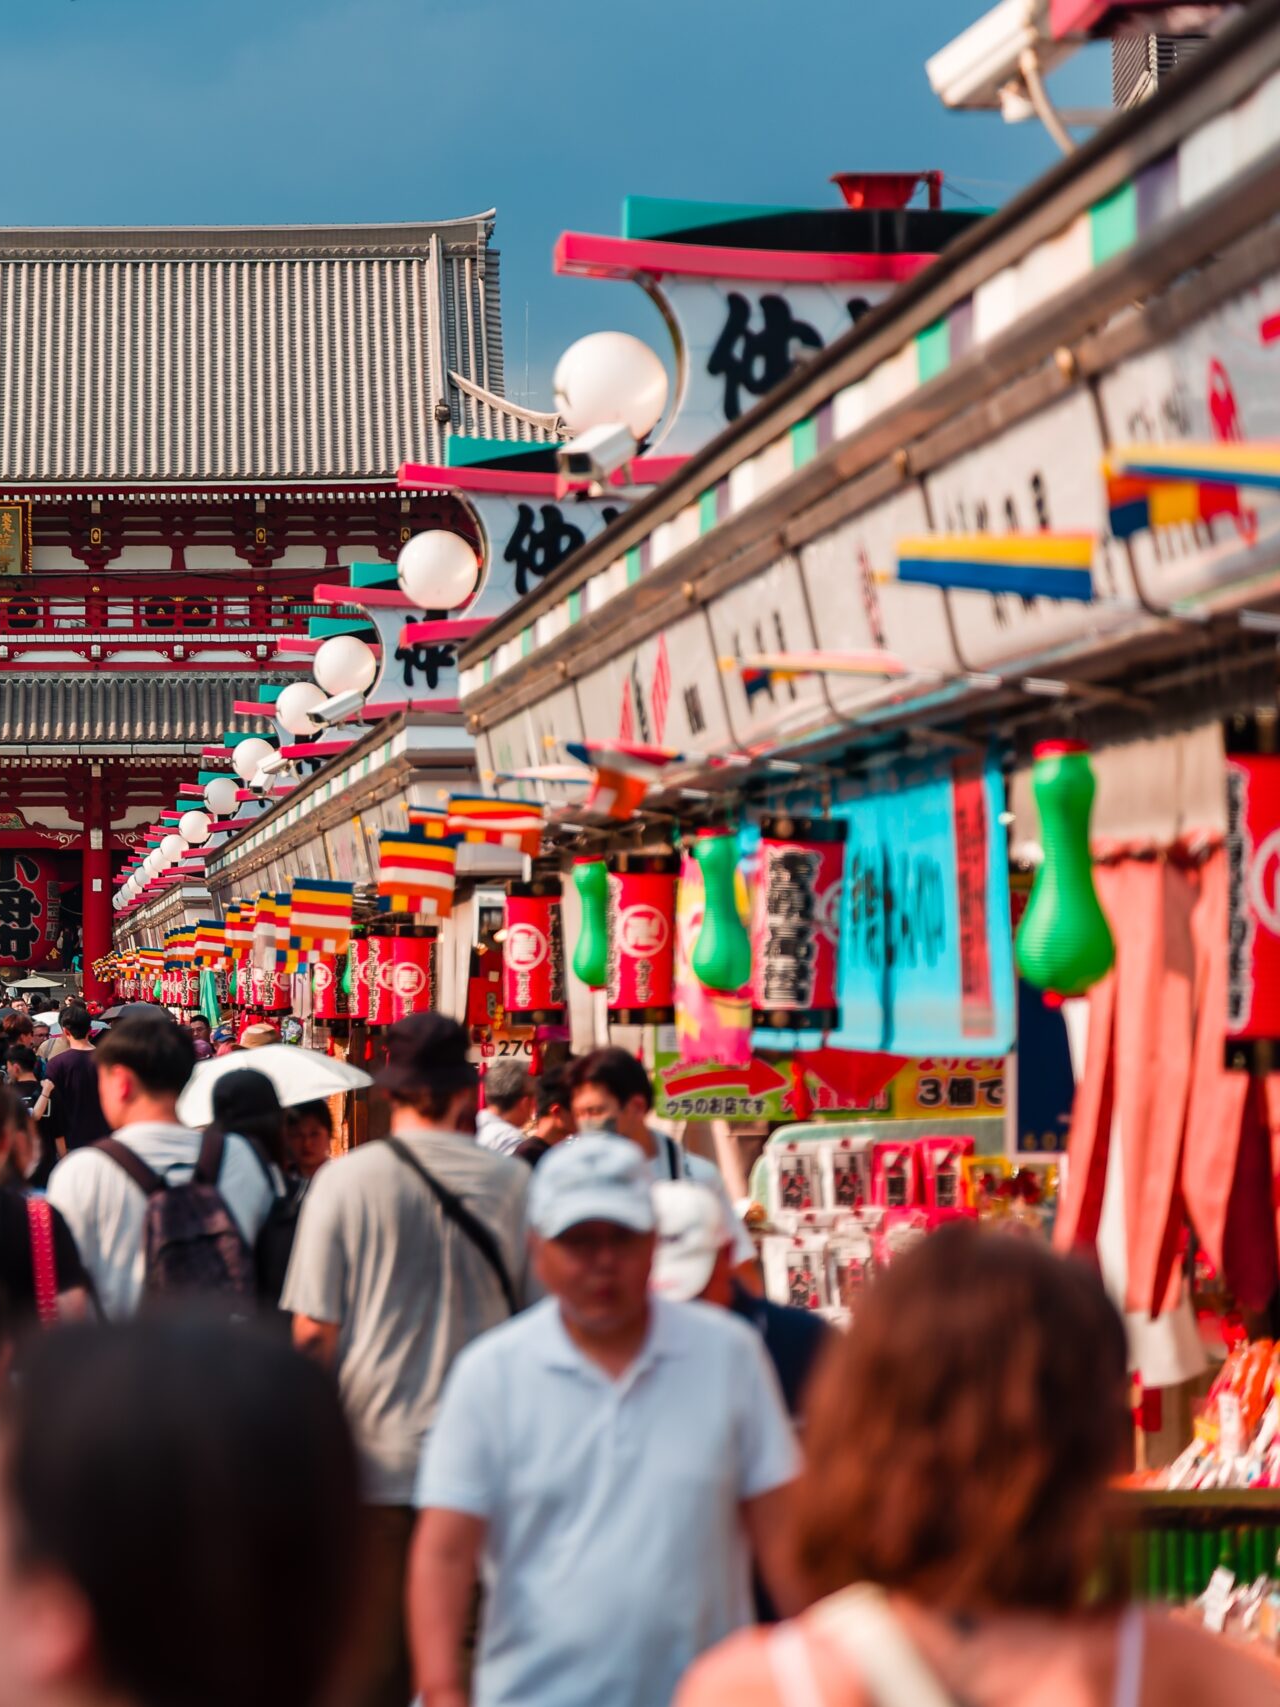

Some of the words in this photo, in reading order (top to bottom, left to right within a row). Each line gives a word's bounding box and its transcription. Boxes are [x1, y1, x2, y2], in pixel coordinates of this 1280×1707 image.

[665, 1097, 766, 1116] ウラのお店です
